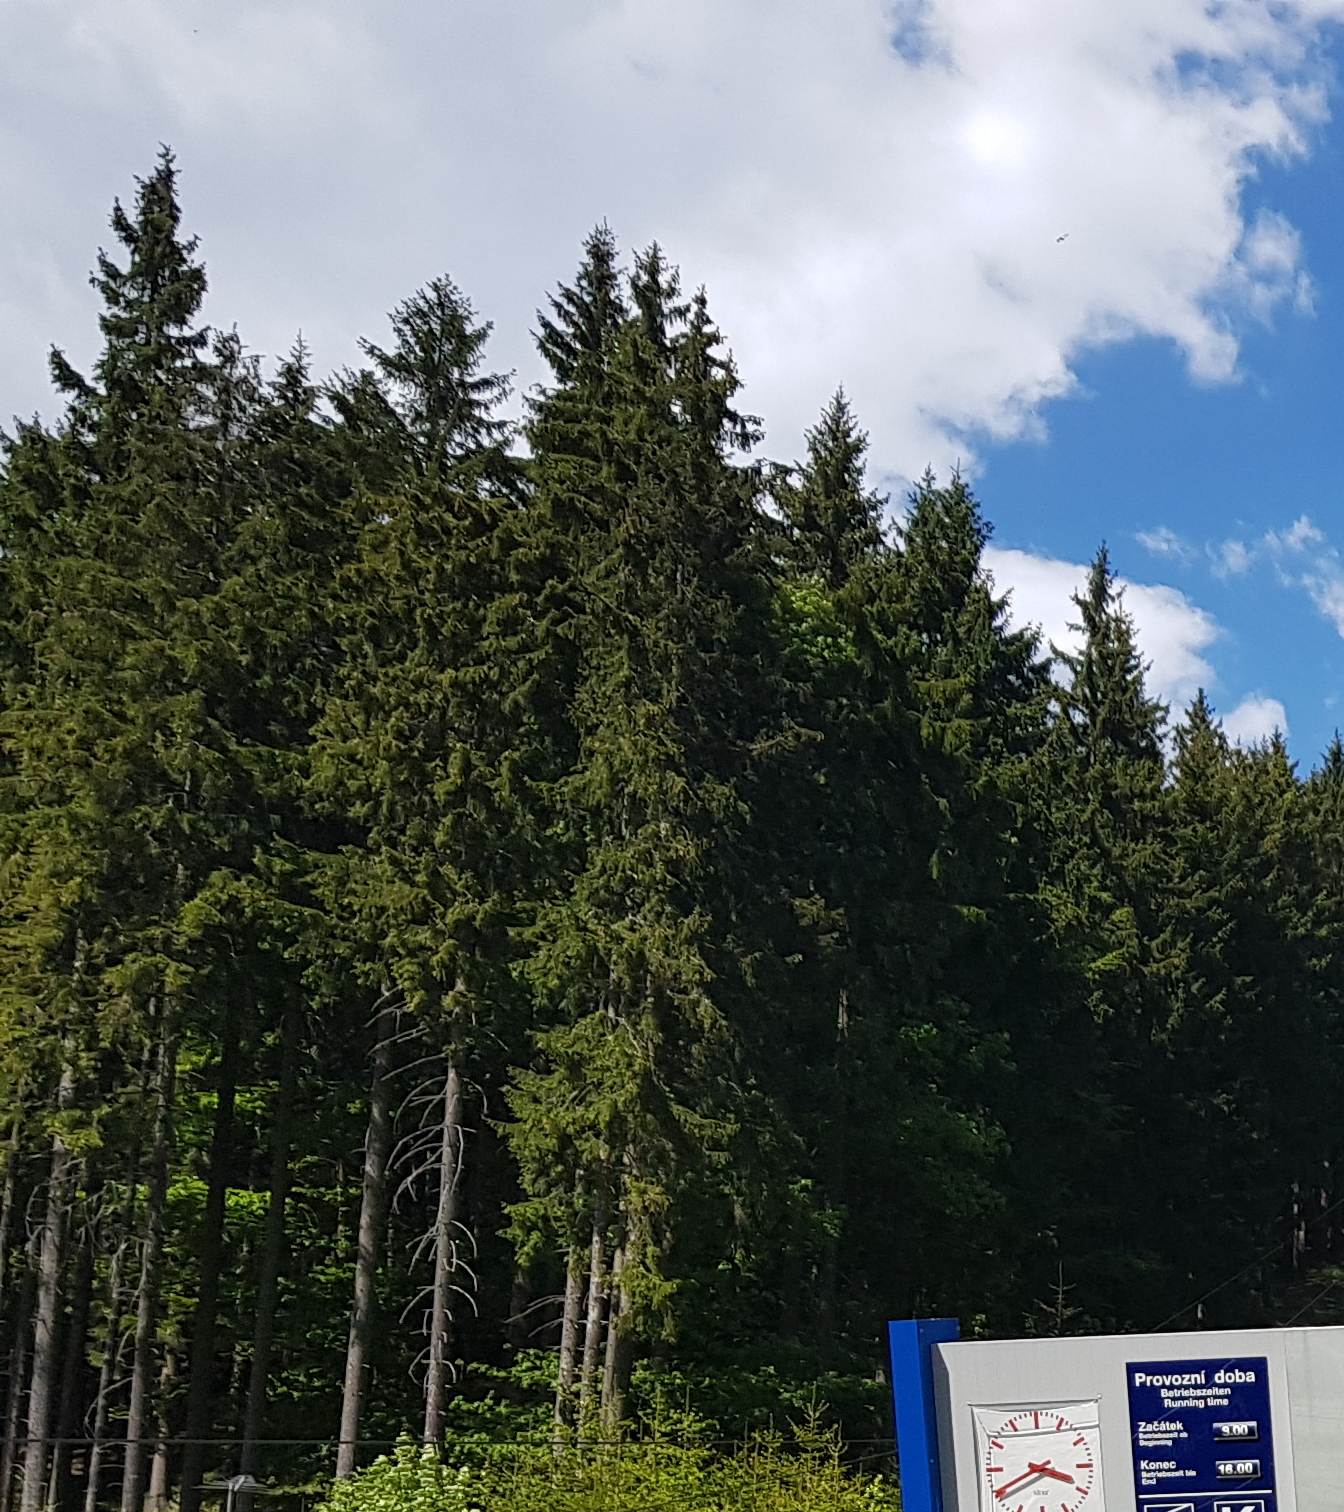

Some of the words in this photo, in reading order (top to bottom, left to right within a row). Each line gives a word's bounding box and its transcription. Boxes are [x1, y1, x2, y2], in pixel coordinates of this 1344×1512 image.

[1135, 1370, 1206, 1386] Provozní
[1214, 1369, 1256, 1383] doba
[1164, 1398, 1205, 1408] Running
[1207, 1397, 1229, 1406] time
[1138, 1421, 1184, 1431] Začátek
[1140, 1460, 1177, 1469] Konec
